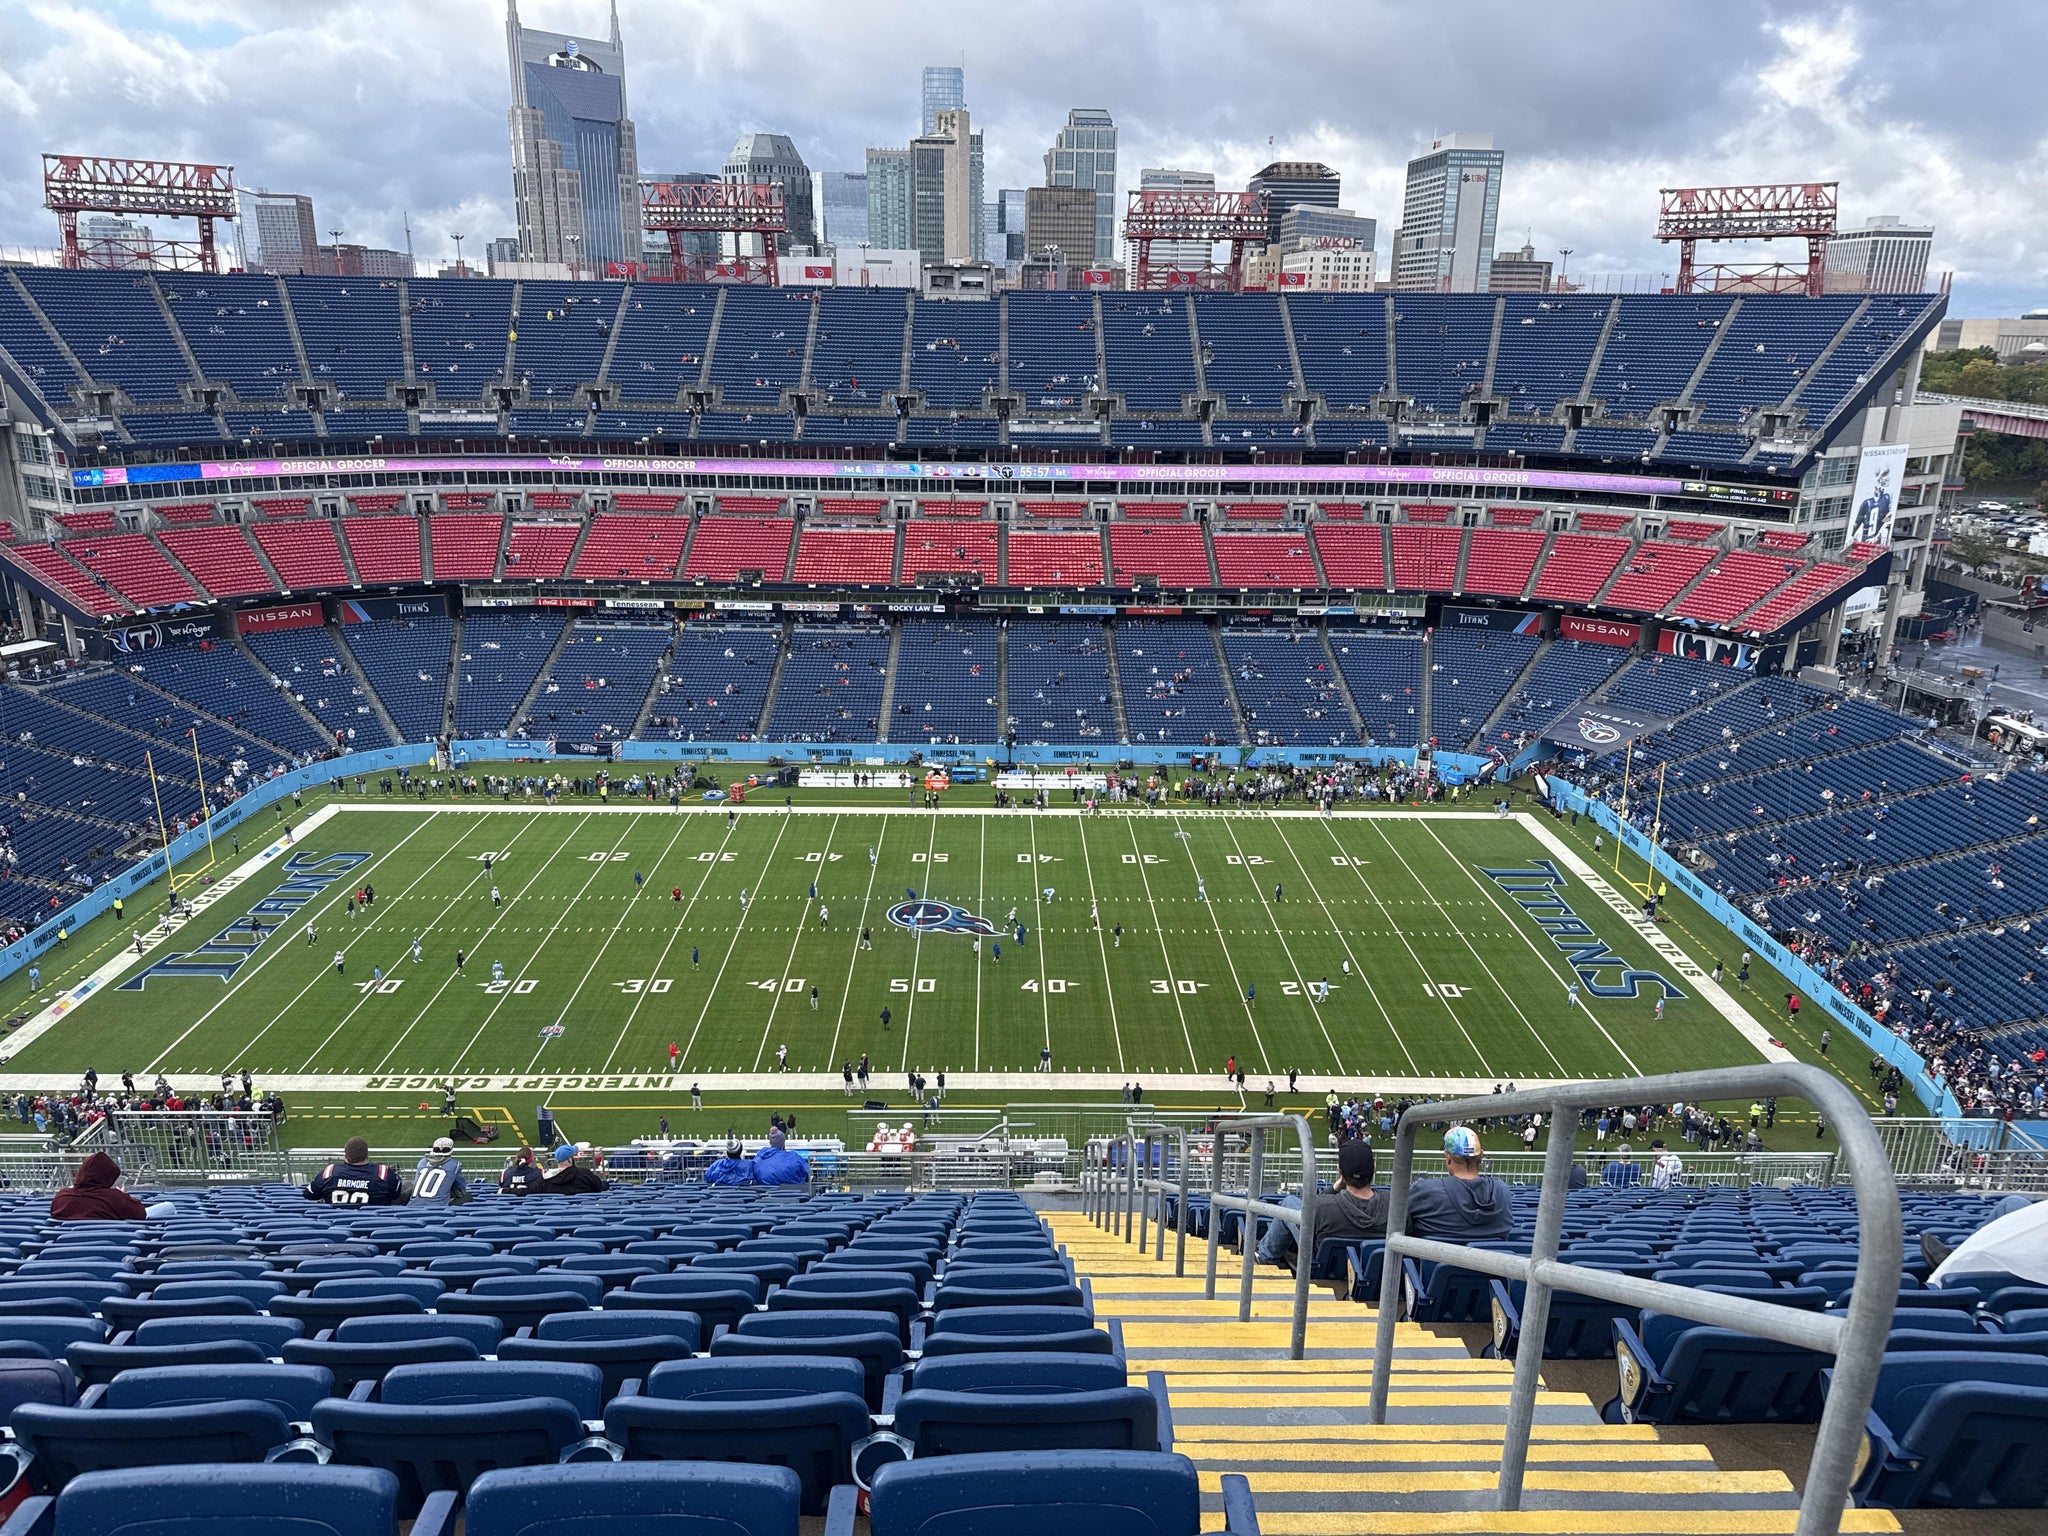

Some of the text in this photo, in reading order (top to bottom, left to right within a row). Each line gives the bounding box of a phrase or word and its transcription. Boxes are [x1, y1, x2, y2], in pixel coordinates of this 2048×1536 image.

[1472, 174, 1486, 182] UBS
[1319, 236, 1364, 250] WKDF
[230, 462, 257, 475] Kroger
[281, 459, 386, 472] OFFICIAL GROCER
[559, 456, 582, 470] Kroger
[603, 458, 696, 470] OFFICIAL GROCER
[1020, 466, 1050, 477] 55:57
[1138, 468, 1226, 478] OFFICIAL GROCER
[1432, 470, 1529, 483] OFFICIAL GROCER
[1868, 506, 1880, 537] 9
[396, 602, 429, 614] TITANS
[248, 608, 312, 623] NISSAN
[1458, 612, 1490, 625] TITANS
[182, 622, 212, 637] Kroger
[1570, 622, 1630, 637] NISSAN
[1584, 710, 1645, 728] NISSAN
[1554, 740, 1584, 752] NISSAN
[587, 852, 631, 861] 20
[696, 852, 738, 862] 30
[804, 852, 844, 862] 40
[911, 853, 949, 863] 50
[1016, 853, 1054, 863] 40
[1121, 854, 1160, 864] 30
[1226, 855, 1266, 865] 20
[1330, 856, 1363, 866] 10
[194, 876, 246, 905] CATCH
[113, 851, 374, 992] TITANS
[1580, 873, 1703, 977] IT TAKES ALL OF US
[1472, 860, 1690, 998] TITANS
[1743, 924, 1777, 960] TENNESSEE TOUGH
[359, 979, 406, 993] 10
[484, 979, 540, 993] 20
[621, 979, 674, 993] 30
[757, 978, 806, 992] 40
[890, 978, 936, 993] 50
[1020, 979, 1066, 993] 40
[1150, 980, 1197, 994] 30
[1280, 981, 1332, 996] 20
[1422, 983, 1462, 998] 10
[1830, 995, 1872, 1038] TENNESSEE TOUGH
[366, 1077, 490, 1089] CANCER
[502, 1076, 674, 1089] INTERCEPT
[336, 1178, 370, 1189] BARMORE
[412, 1168, 447, 1198] 10
